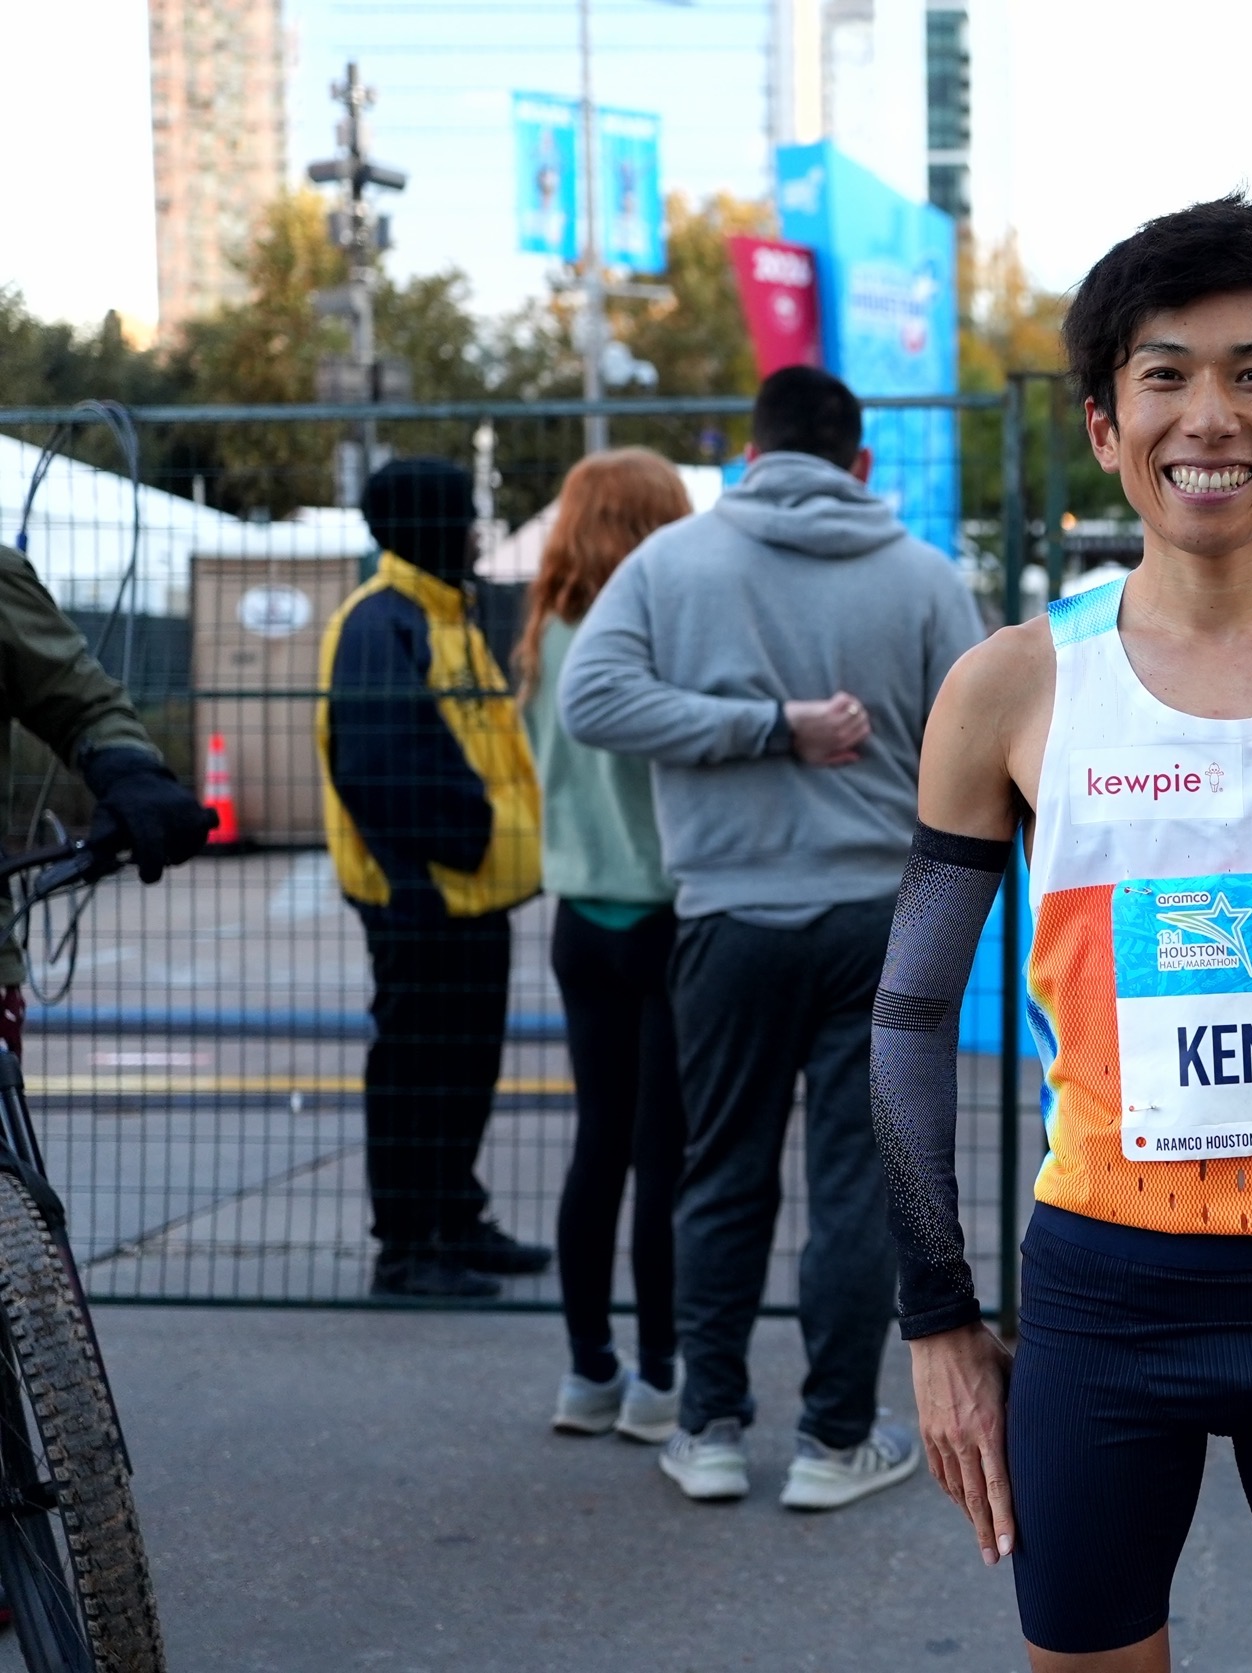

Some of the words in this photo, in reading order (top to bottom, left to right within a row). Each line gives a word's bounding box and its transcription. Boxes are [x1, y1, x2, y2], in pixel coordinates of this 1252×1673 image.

[1087, 763, 1201, 801] kewpie
[1157, 893, 1209, 905] aramco
[1159, 931, 1181, 945] 13.1
[1159, 944, 1225, 959] HOUSTON
[1159, 960, 1183, 970] HALF
[1185, 957, 1238, 968] MARATHON
[1156, 1136, 1202, 1152] ARAMCO
